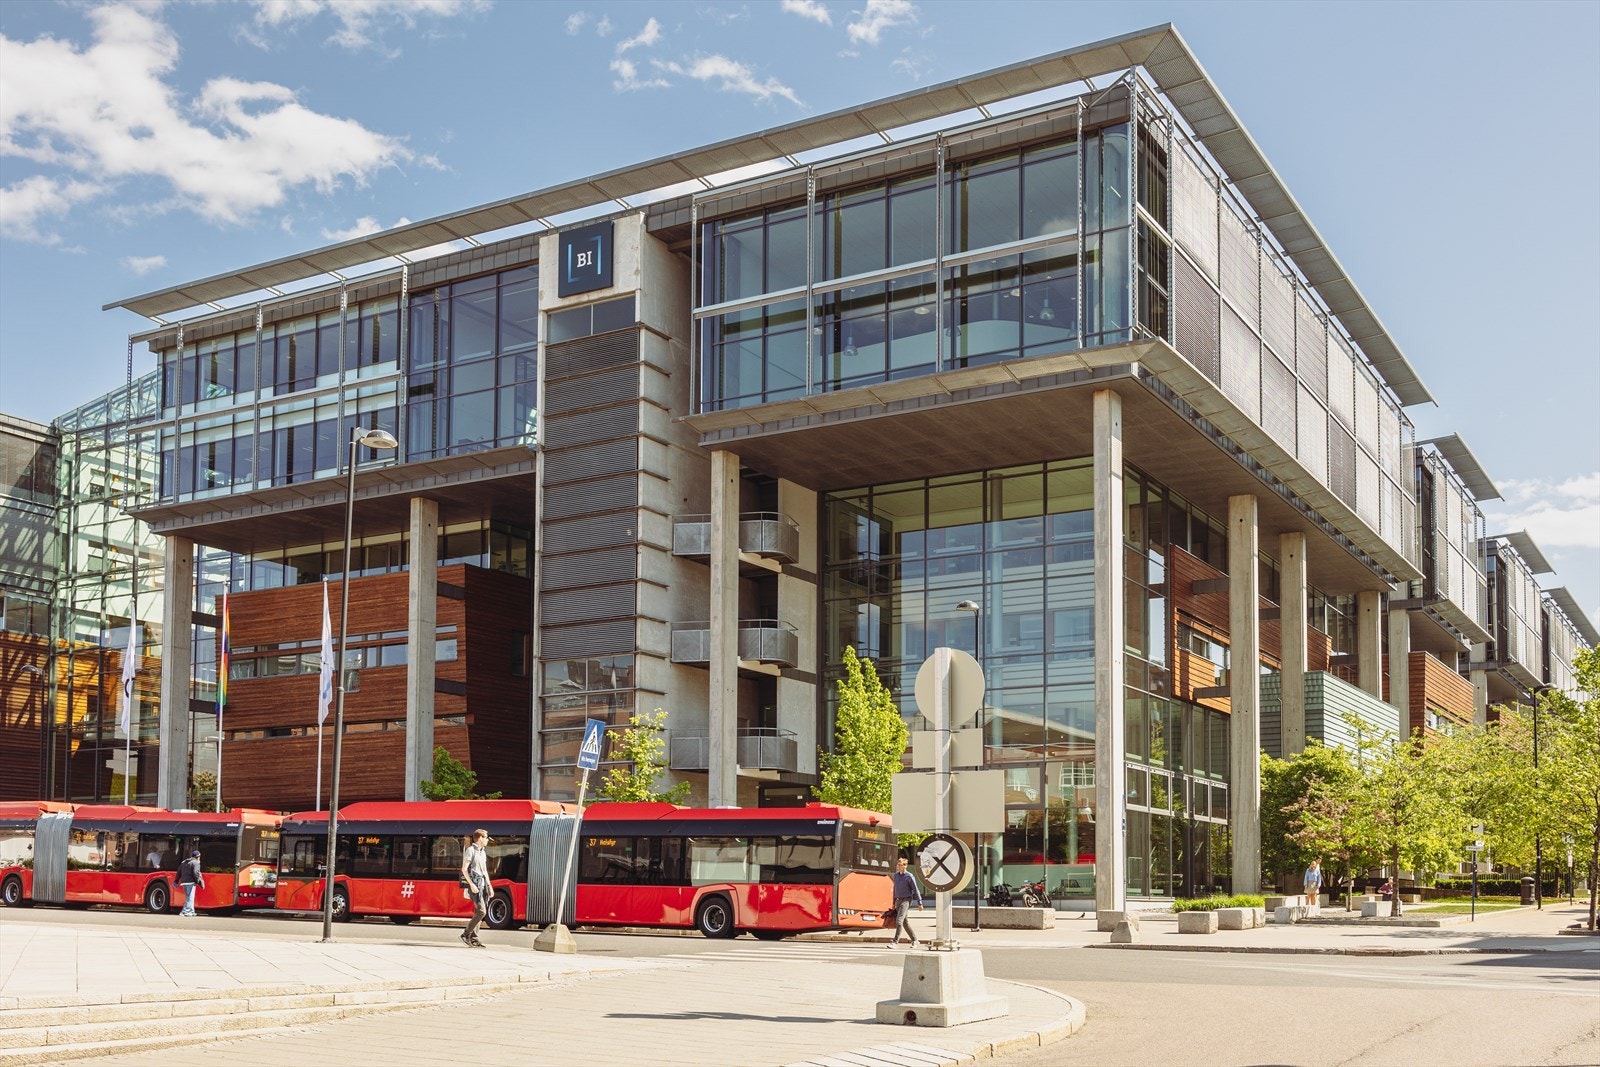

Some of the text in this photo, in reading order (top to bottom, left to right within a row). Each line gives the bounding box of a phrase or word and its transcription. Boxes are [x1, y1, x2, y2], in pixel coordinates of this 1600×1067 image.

[576, 250, 592, 268] BI
[261, 830, 268, 838] 37
[358, 836, 365, 845] 37
[589, 838, 597, 847] 37
